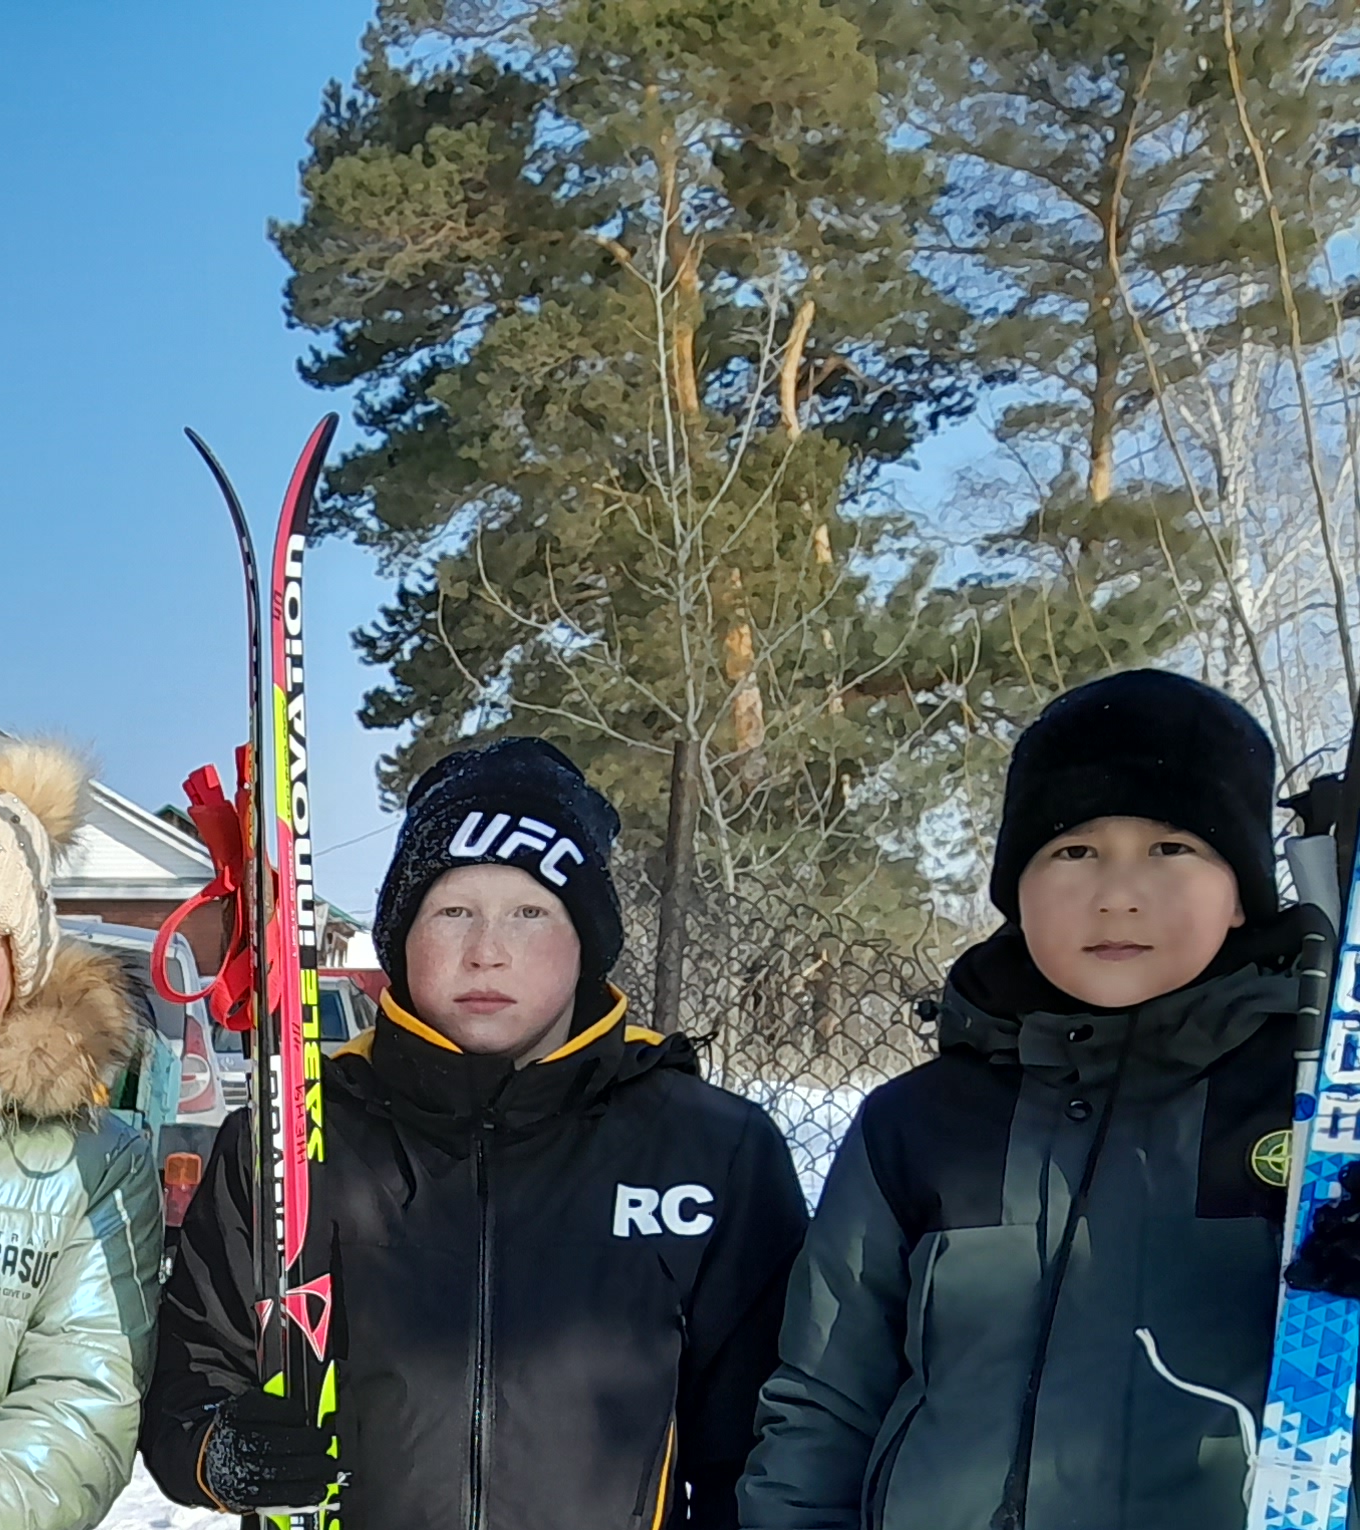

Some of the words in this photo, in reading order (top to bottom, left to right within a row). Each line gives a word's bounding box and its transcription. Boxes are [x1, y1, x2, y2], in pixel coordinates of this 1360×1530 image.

[448, 811, 585, 887] UFC
[300, 968, 323, 1162] SABLE
[612, 1183, 714, 1238] RC
[2, 1287, 21, 1299] GIVE
[22, 1292, 32, 1300] UP
